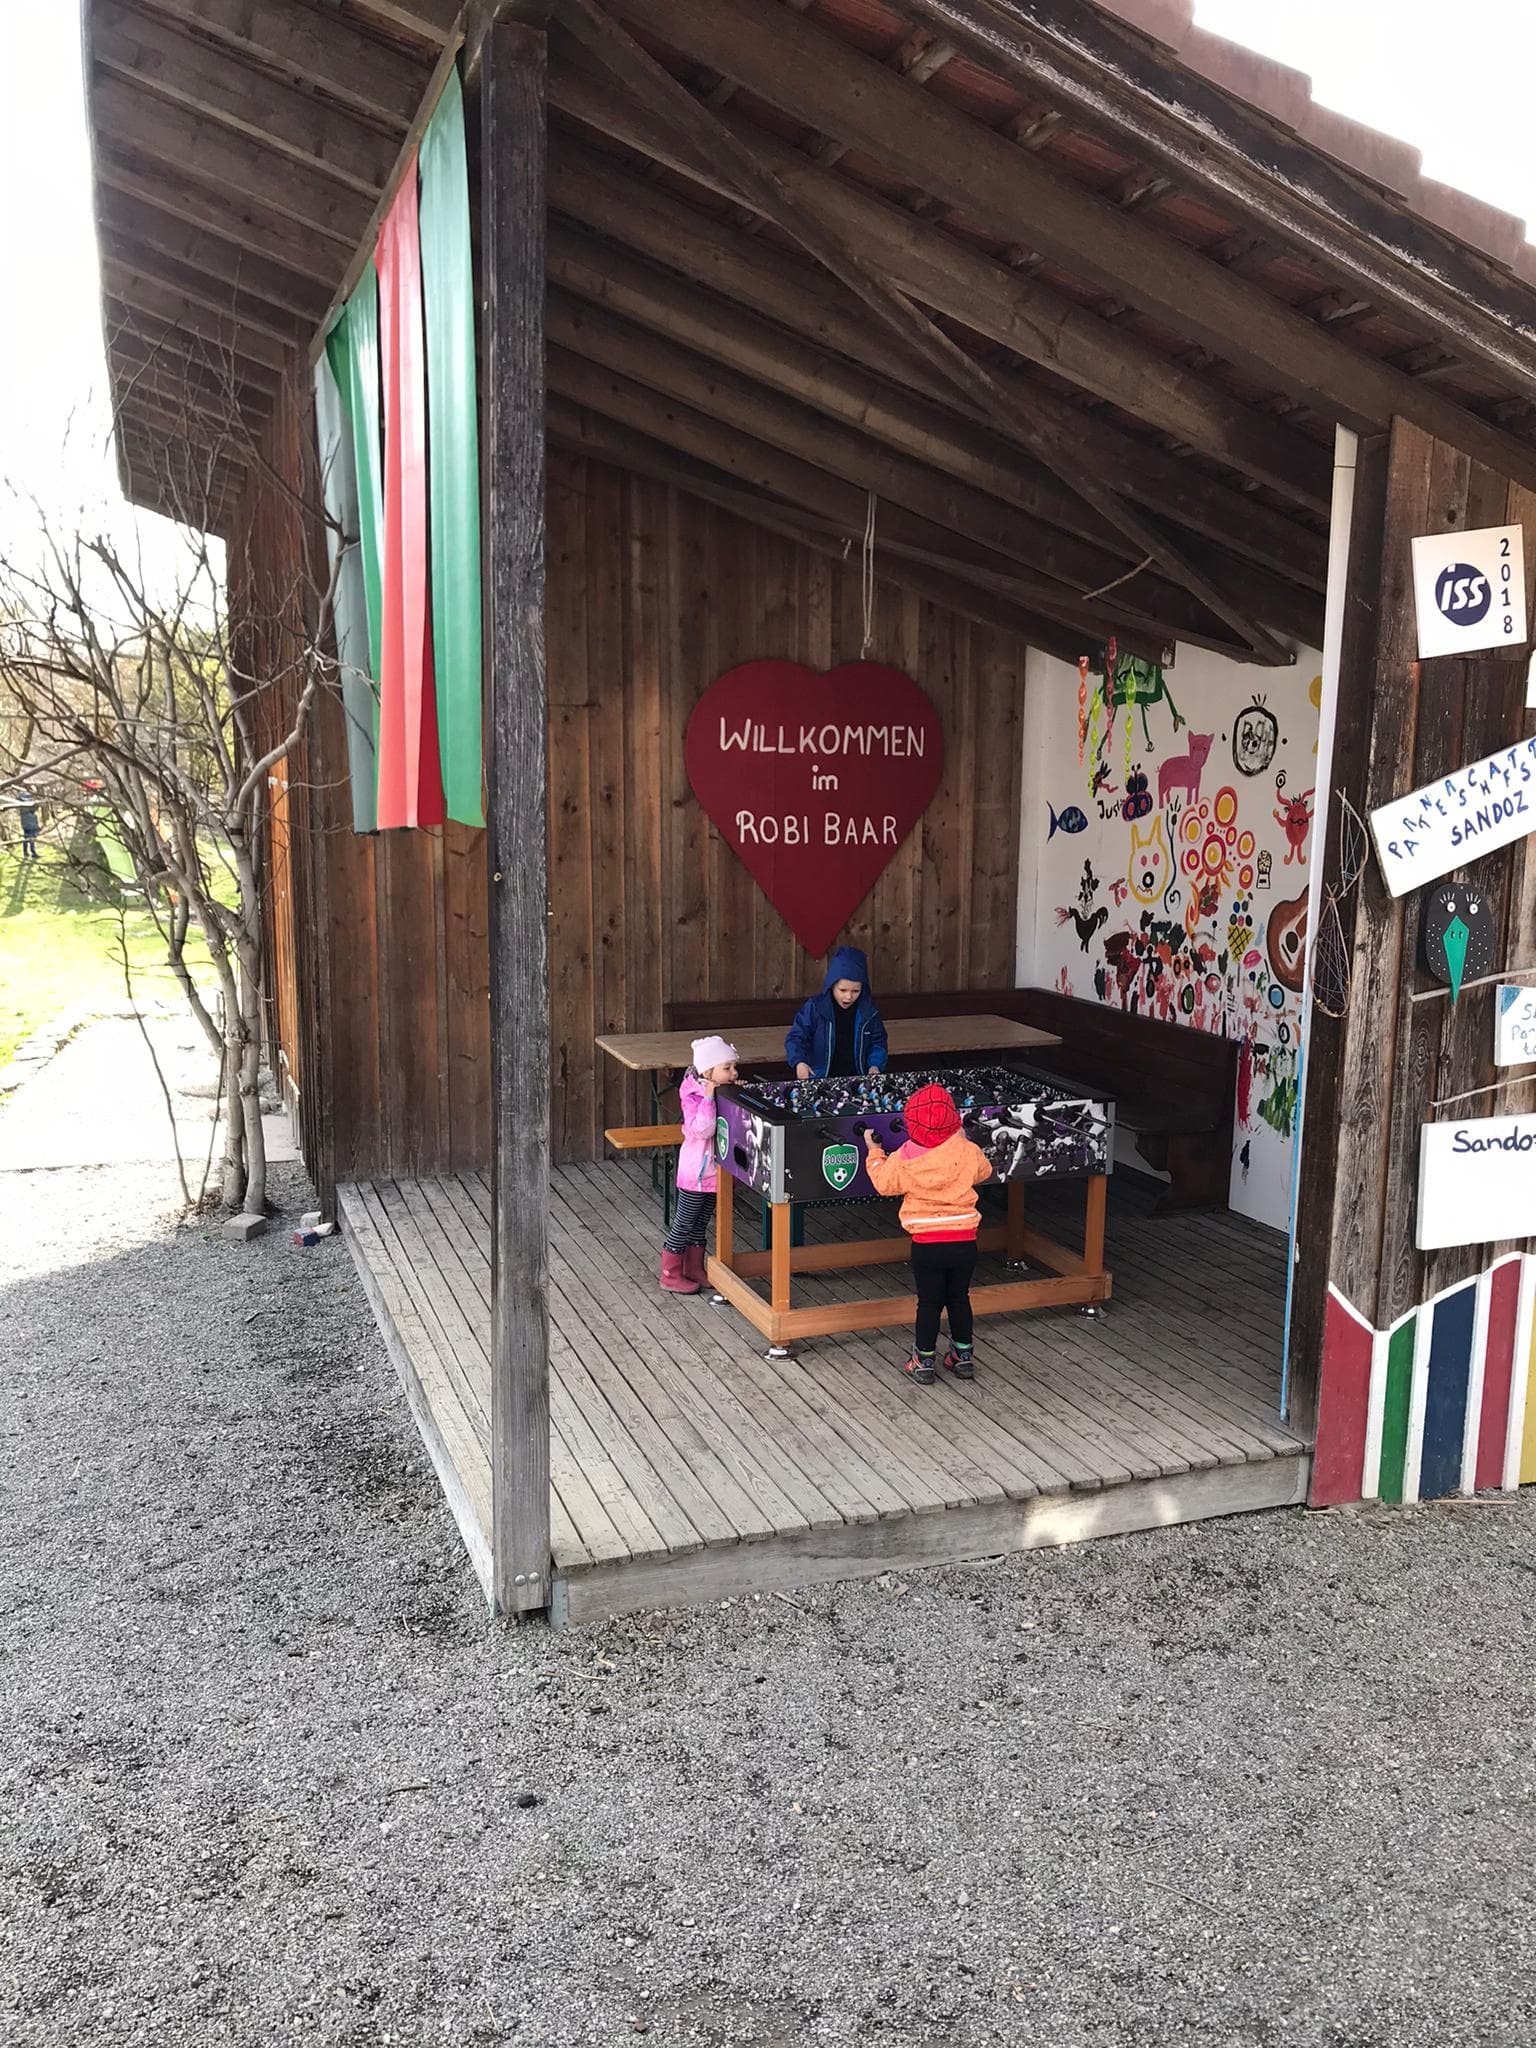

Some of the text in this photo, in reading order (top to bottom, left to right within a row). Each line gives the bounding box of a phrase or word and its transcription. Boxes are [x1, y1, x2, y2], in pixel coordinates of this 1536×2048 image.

[1500, 538, 1513, 634] 2018
[720, 717, 925, 758] WILLKOMMEN
[812, 765, 839, 790] im
[736, 810, 898, 845] ROBI BAAR
[1451, 791, 1529, 847] SANDOZ
